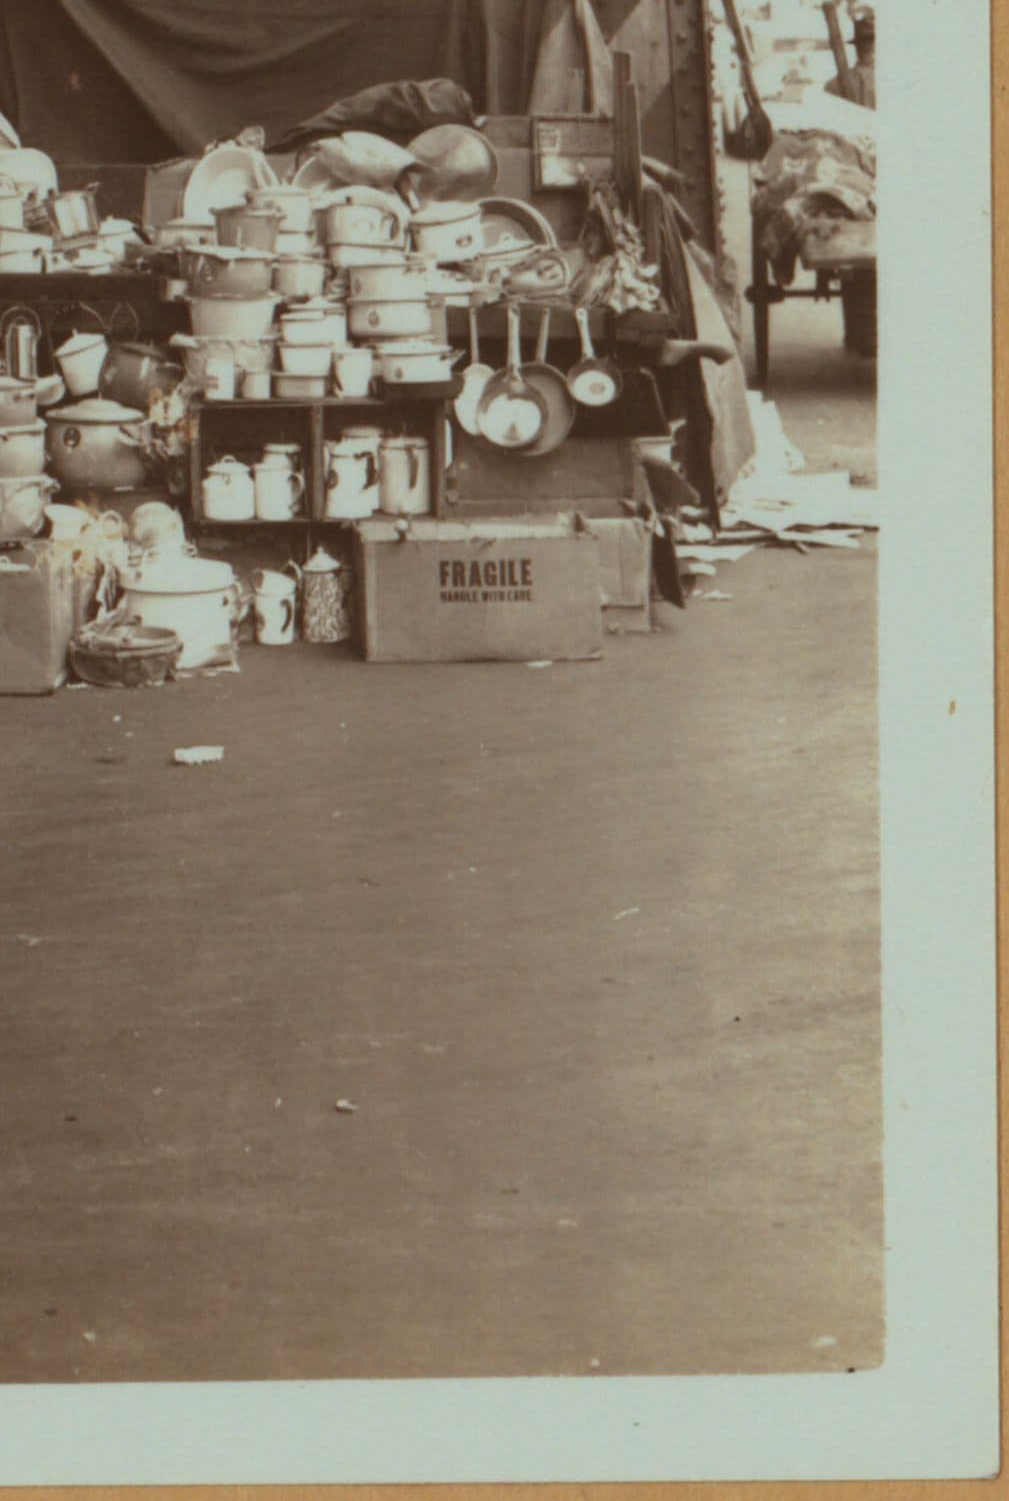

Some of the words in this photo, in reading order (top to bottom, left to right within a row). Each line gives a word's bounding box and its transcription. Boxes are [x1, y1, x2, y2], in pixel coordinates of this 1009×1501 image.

[439, 559, 532, 586] FRAGILE
[439, 589, 480, 603] HANDLE
[481, 589, 506, 602] WITH
